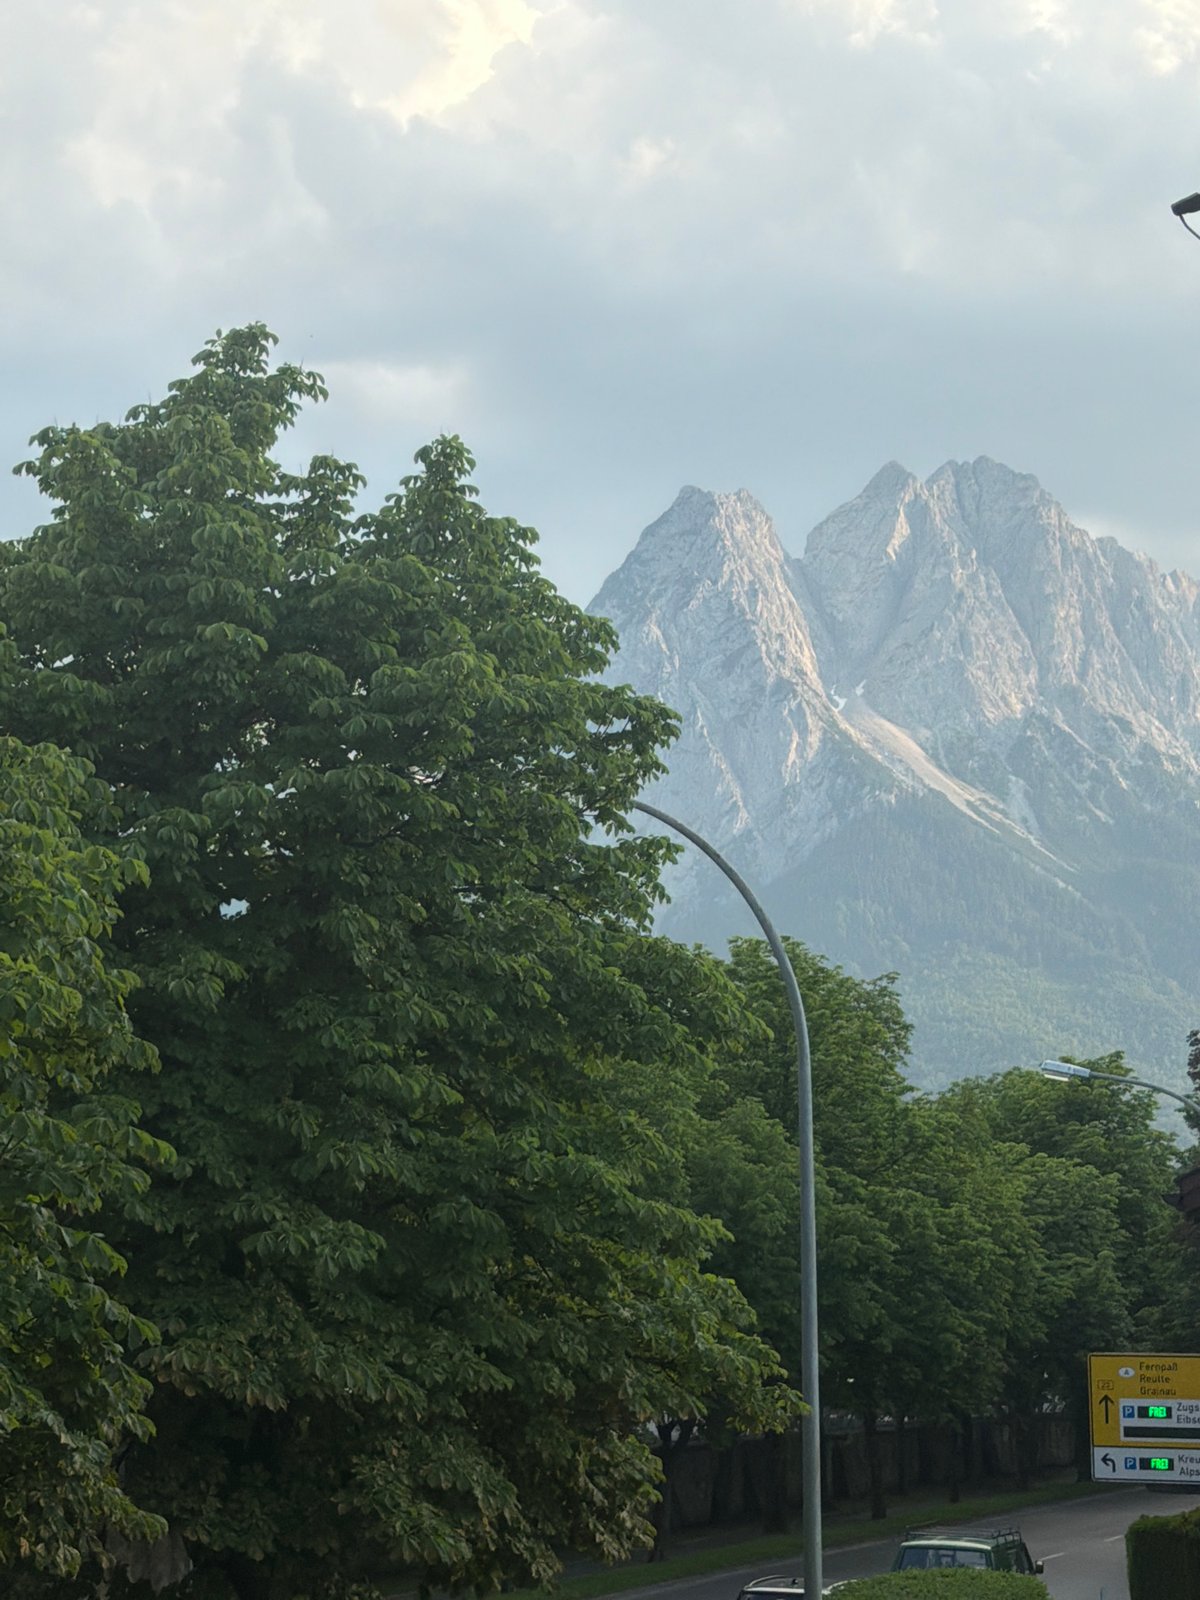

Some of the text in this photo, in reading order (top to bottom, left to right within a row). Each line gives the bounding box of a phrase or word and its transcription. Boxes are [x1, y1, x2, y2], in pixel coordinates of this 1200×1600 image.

[1139, 1361, 1178, 1373] Fernpaß
[1139, 1374, 1171, 1383] Reutte
[1140, 1387, 1177, 1396] Grainau
